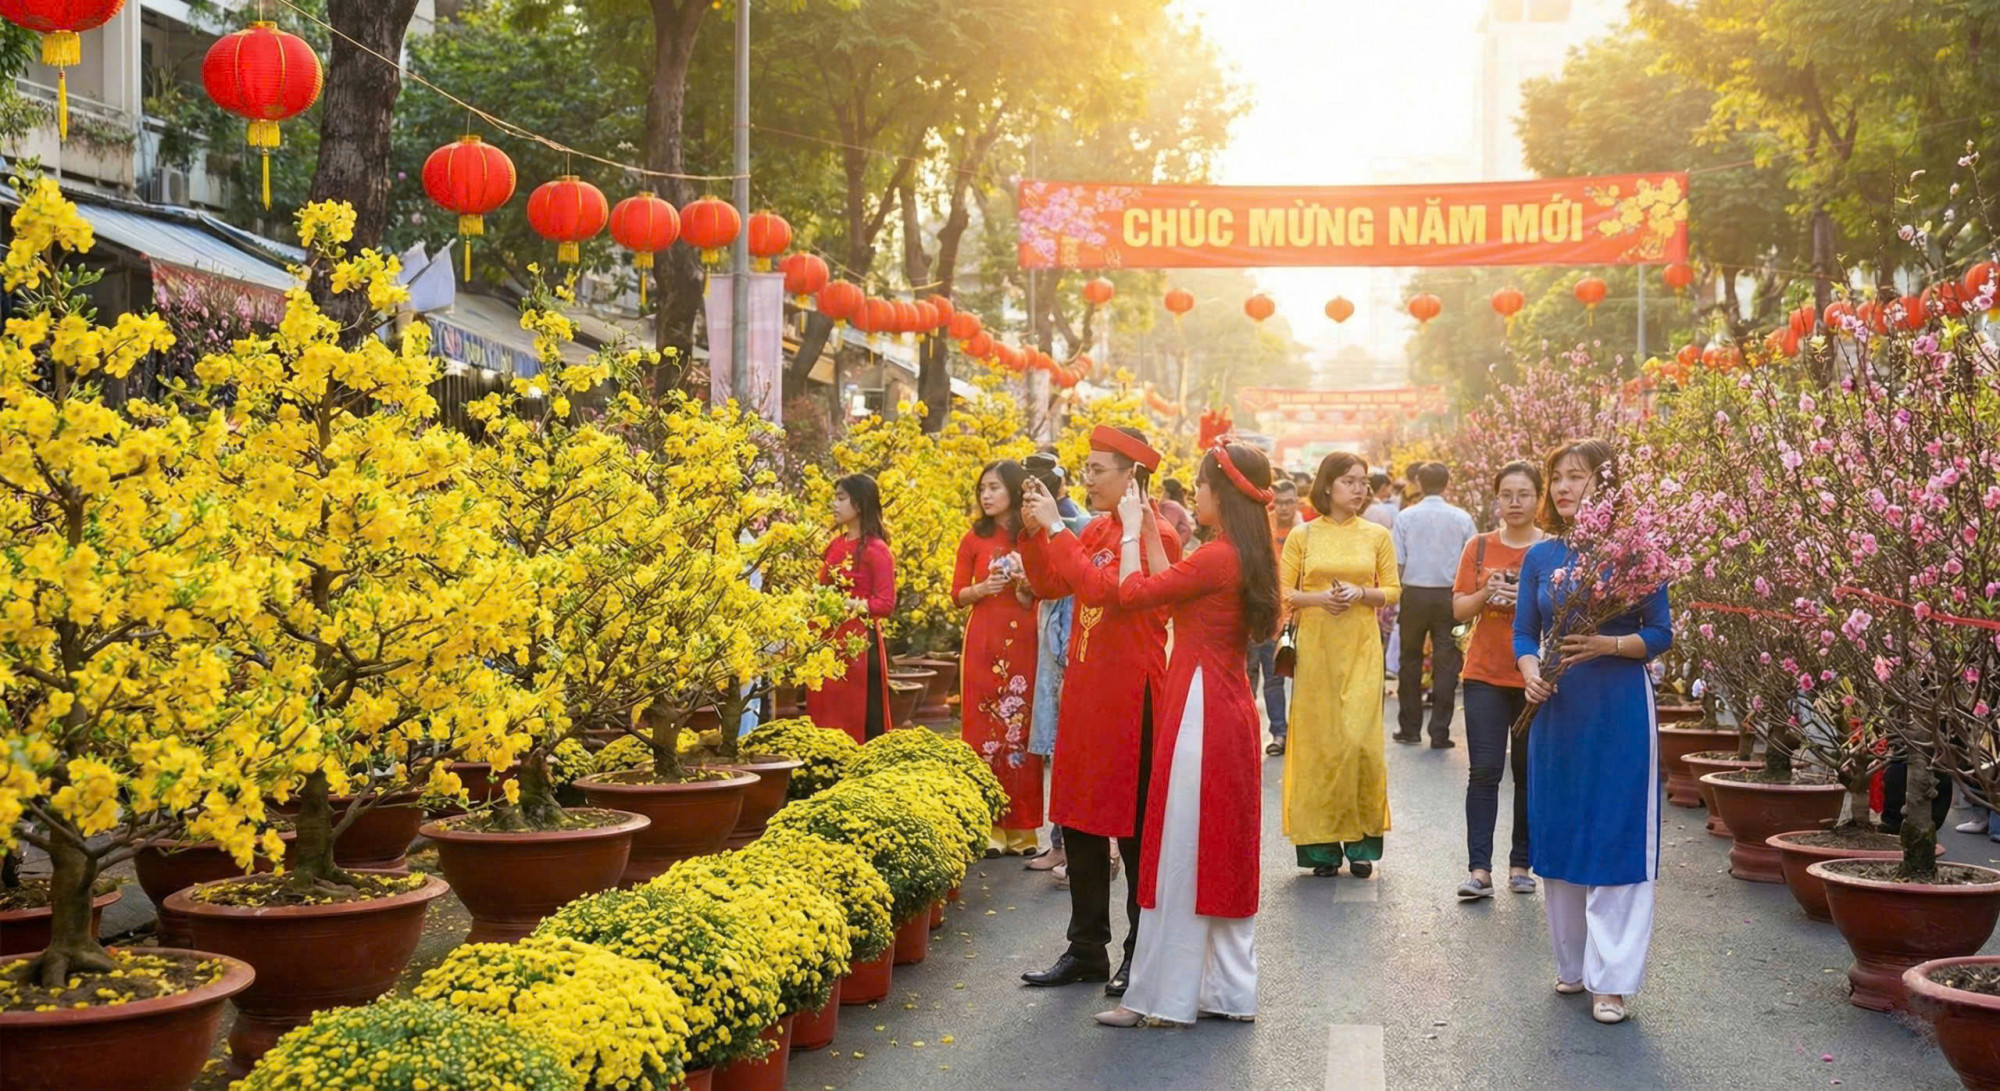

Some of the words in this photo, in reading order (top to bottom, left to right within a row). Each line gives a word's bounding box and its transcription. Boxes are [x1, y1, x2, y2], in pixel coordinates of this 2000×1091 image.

[1123, 199, 1234, 248] CHÚC
[1249, 198, 1374, 247] MỪNG
[1389, 196, 1486, 245] NĂM
[1502, 193, 1583, 244] MỚI
